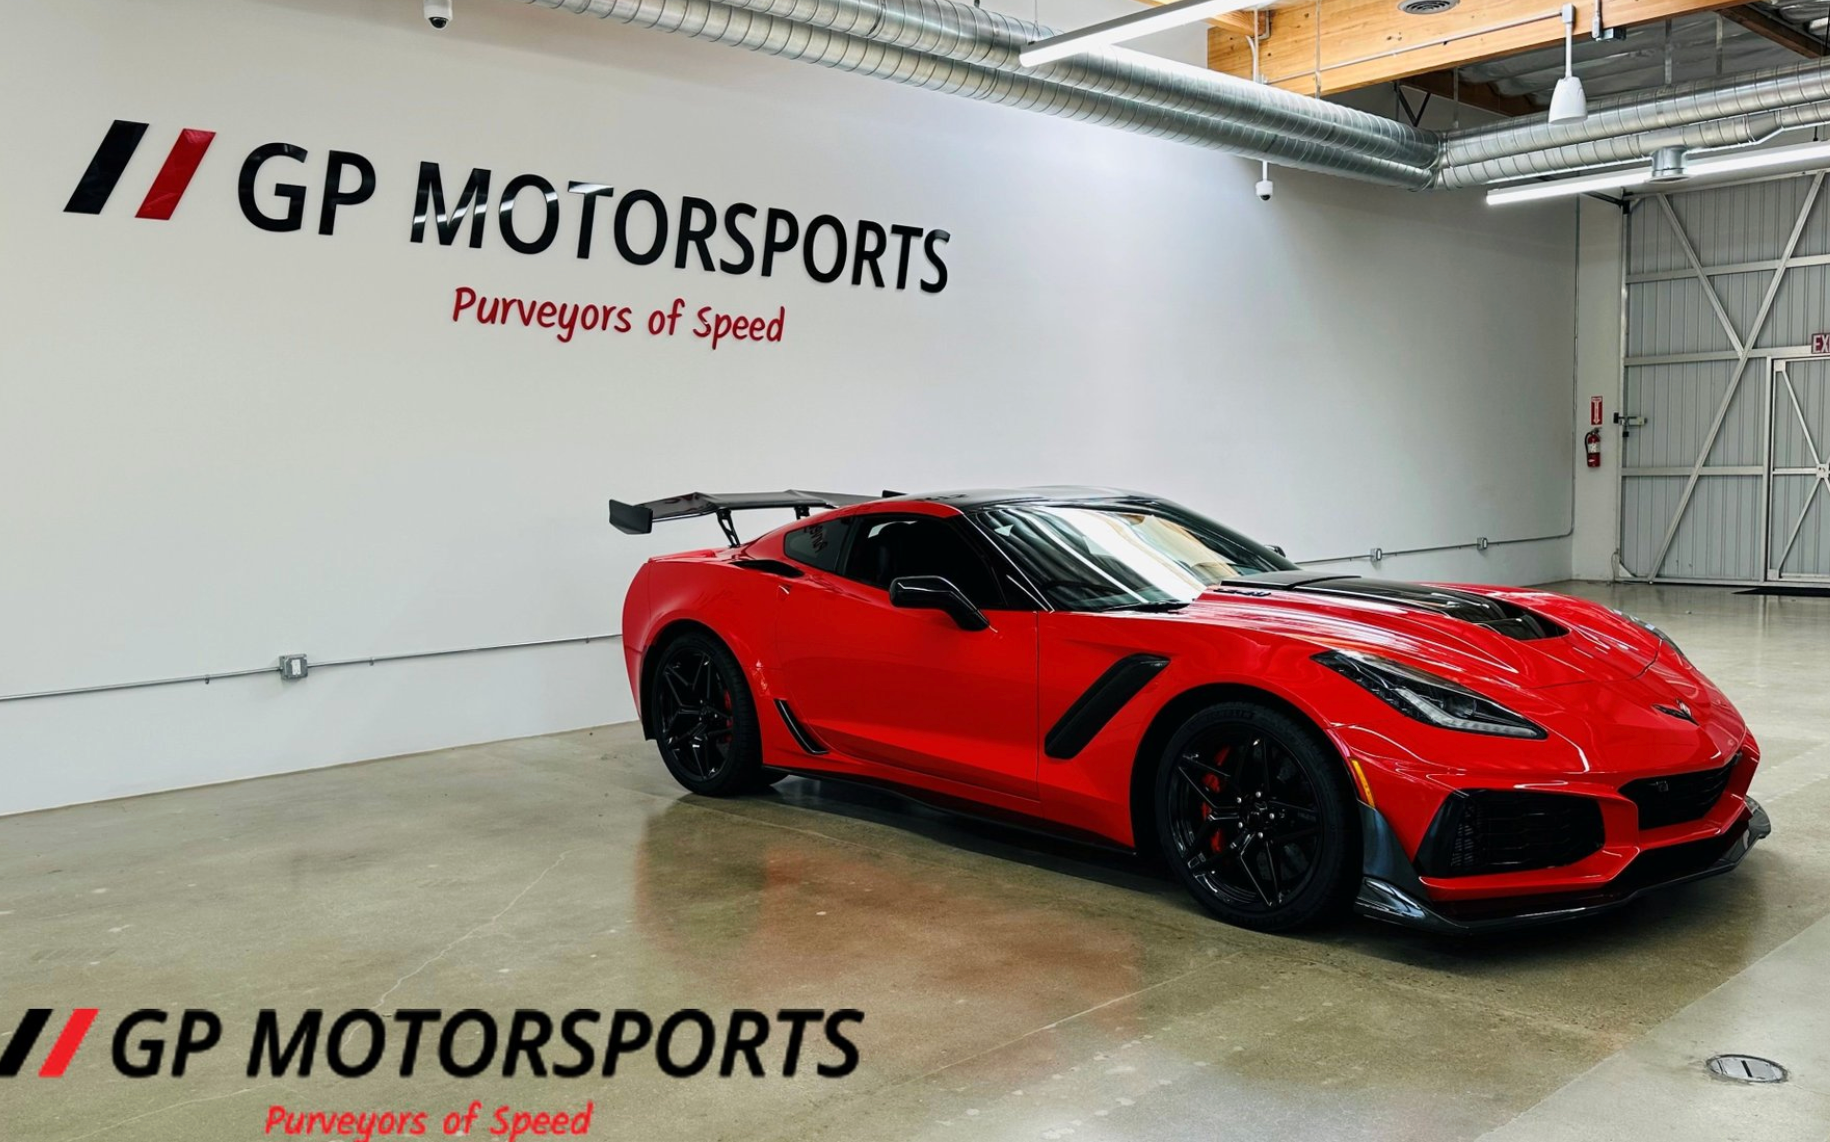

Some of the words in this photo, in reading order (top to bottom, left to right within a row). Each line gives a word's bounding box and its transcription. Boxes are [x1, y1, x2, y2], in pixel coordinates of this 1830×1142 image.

[237, 142, 377, 236] GP
[410, 160, 951, 294] MOTORSPORTS
[452, 286, 633, 343] Purveyors
[648, 298, 685, 335] of
[693, 306, 786, 350] Speed
